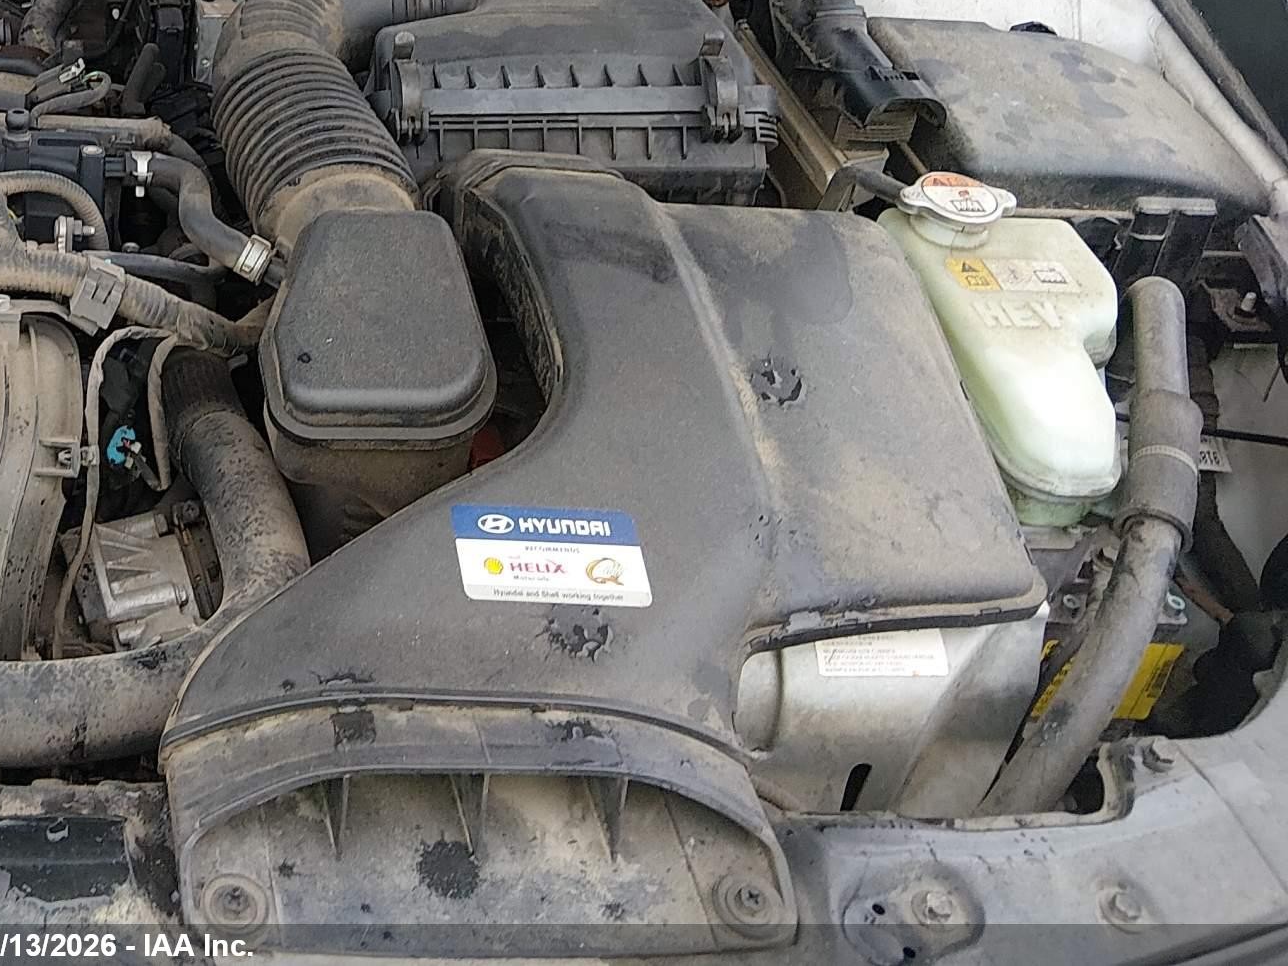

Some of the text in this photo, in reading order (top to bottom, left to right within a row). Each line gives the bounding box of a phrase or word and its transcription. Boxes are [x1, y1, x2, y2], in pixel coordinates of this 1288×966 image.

[972, 300, 1063, 330] HEV
[518, 517, 611, 536] HYUNDAI
[510, 559, 567, 574] HELIX
[493, 588, 624, 601] Hyundai and Shell working together
